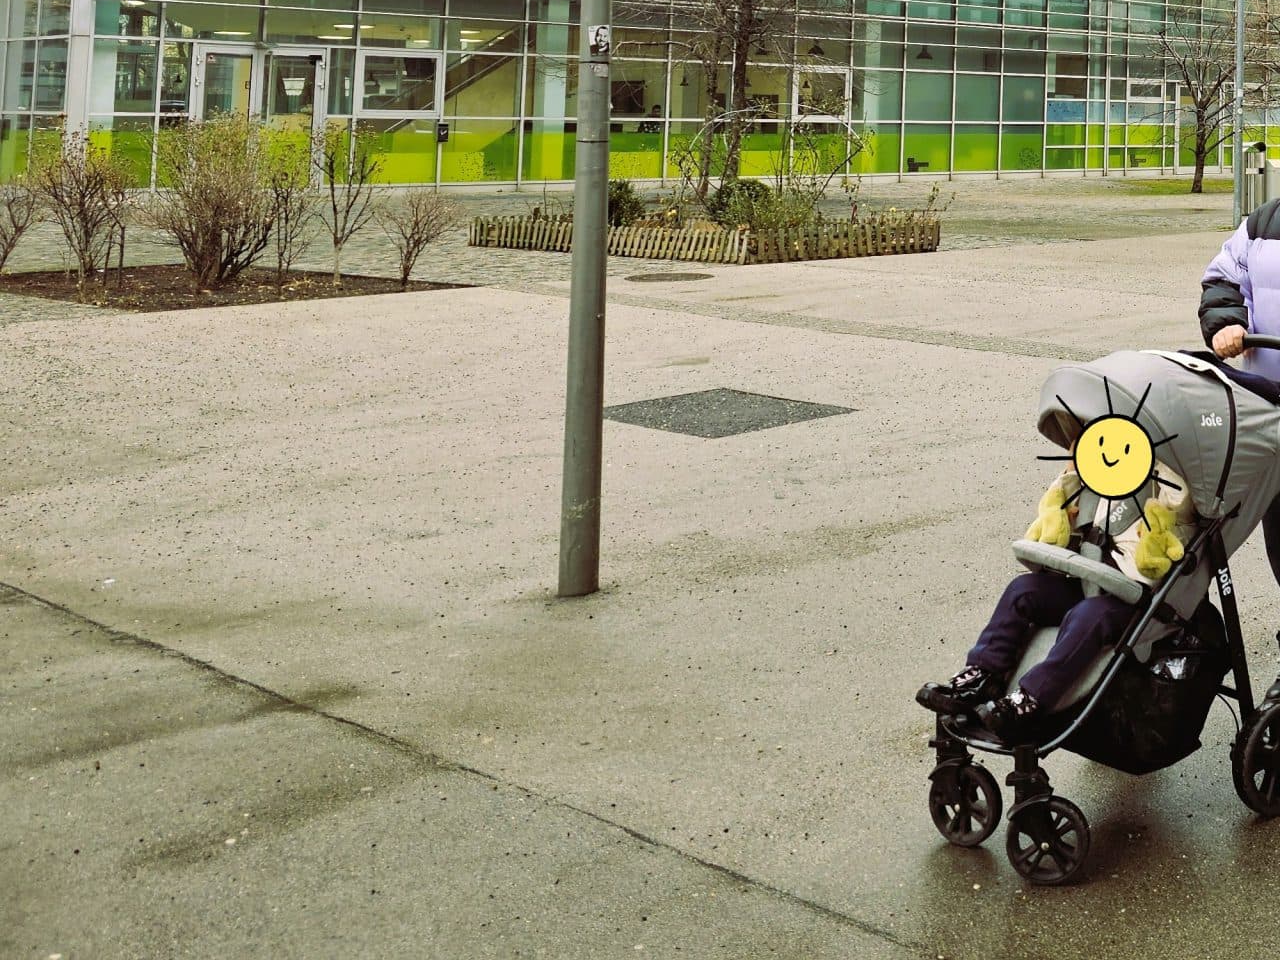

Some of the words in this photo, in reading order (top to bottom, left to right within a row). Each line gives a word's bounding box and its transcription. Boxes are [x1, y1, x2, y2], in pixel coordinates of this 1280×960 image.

[1200, 412, 1223, 427] Joie
[1109, 501, 1128, 523] Joie
[1217, 567, 1232, 596] Joie
